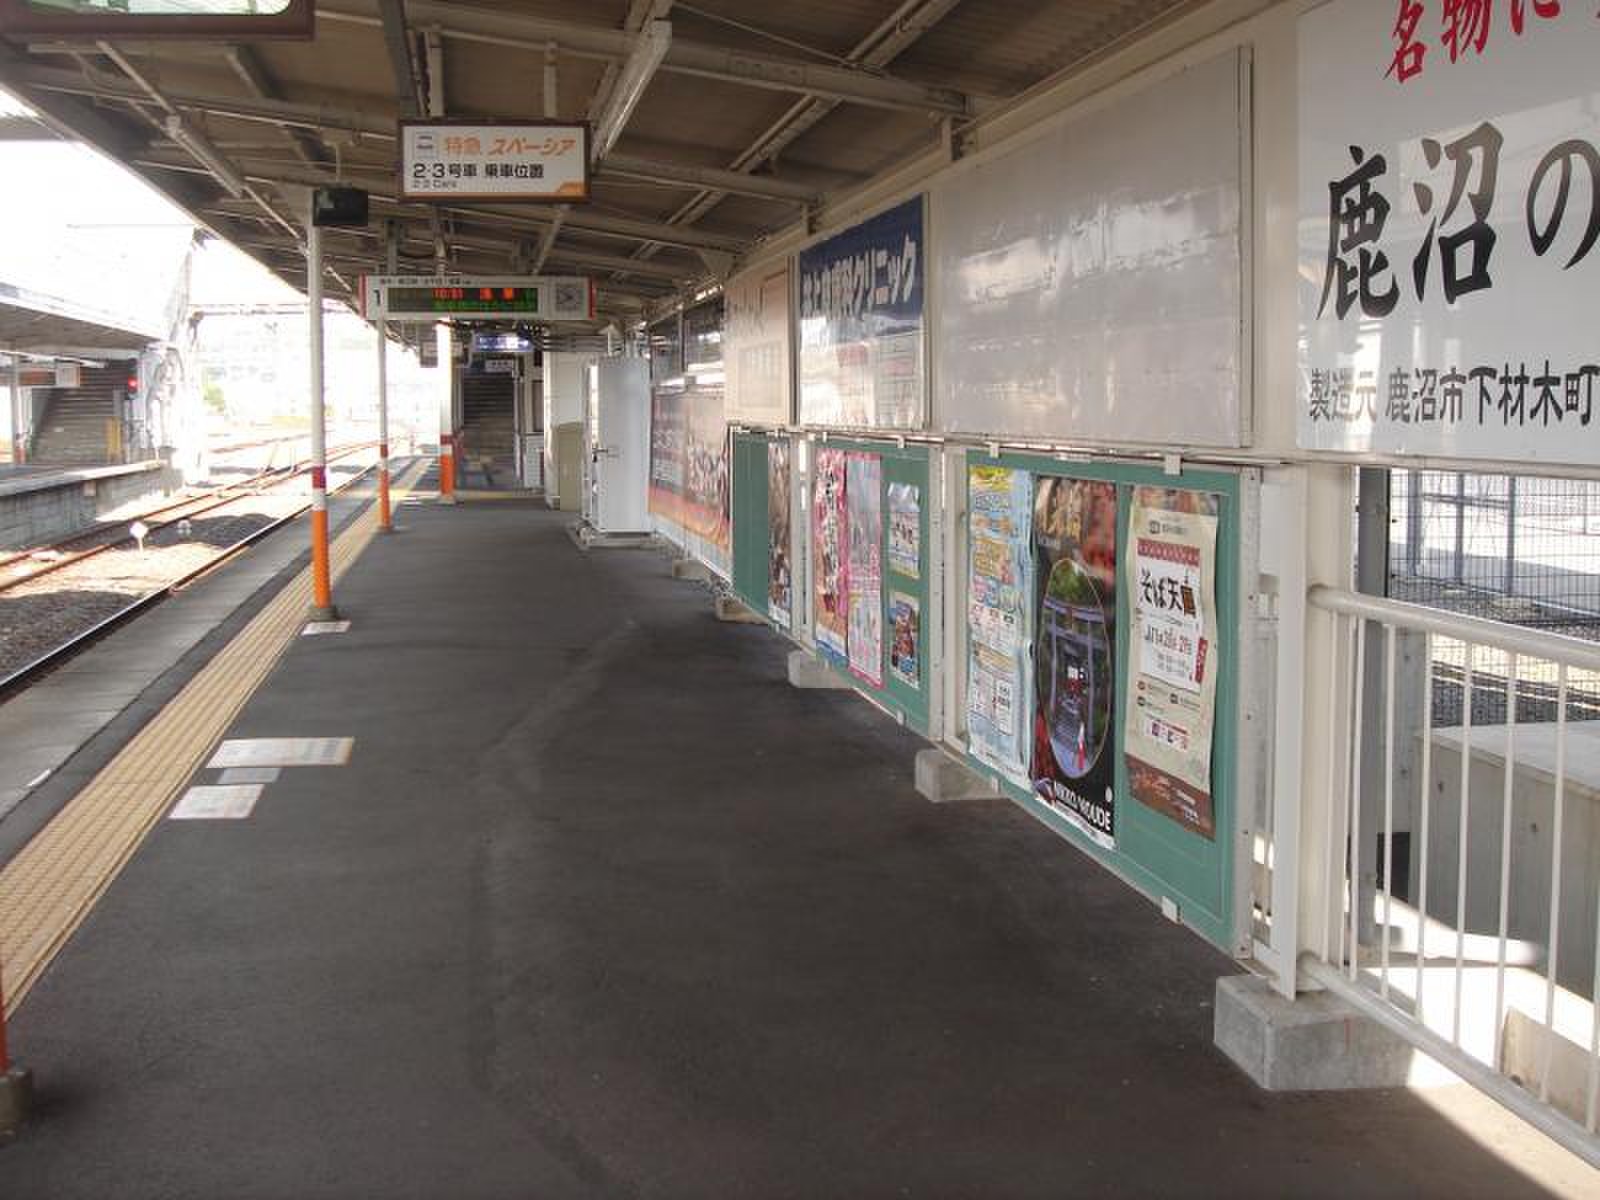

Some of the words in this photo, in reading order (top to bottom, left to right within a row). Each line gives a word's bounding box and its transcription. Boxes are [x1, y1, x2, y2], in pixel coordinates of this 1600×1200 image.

[1315, 121, 1600, 321] 鹿沼の
[1309, 367, 1377, 423] 製造元
[1385, 360, 1600, 427] 鹿沼市下材木町
